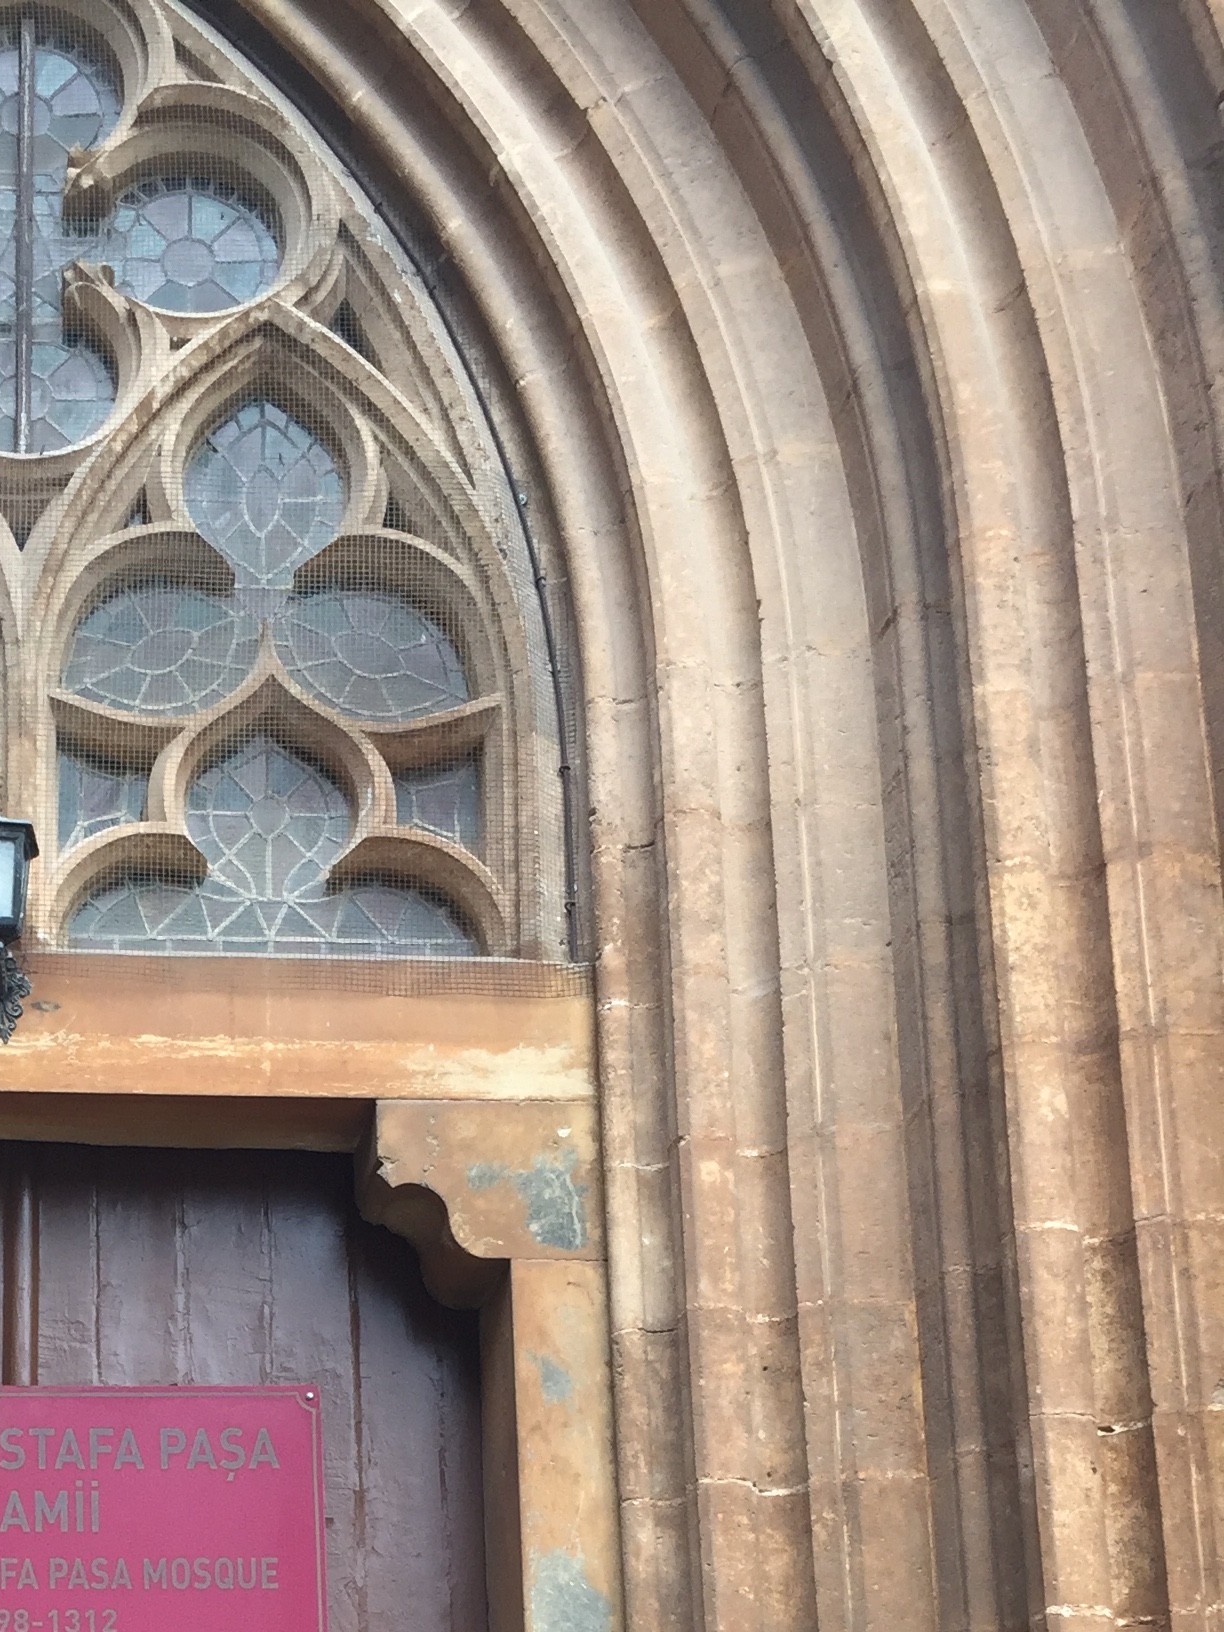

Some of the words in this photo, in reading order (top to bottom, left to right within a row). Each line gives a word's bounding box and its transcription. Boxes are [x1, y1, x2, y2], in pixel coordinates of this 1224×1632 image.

[160, 1428, 281, 1481] PAŞA
[49, 1558, 133, 1590] PASA
[144, 1557, 280, 1591] MOSQUE
